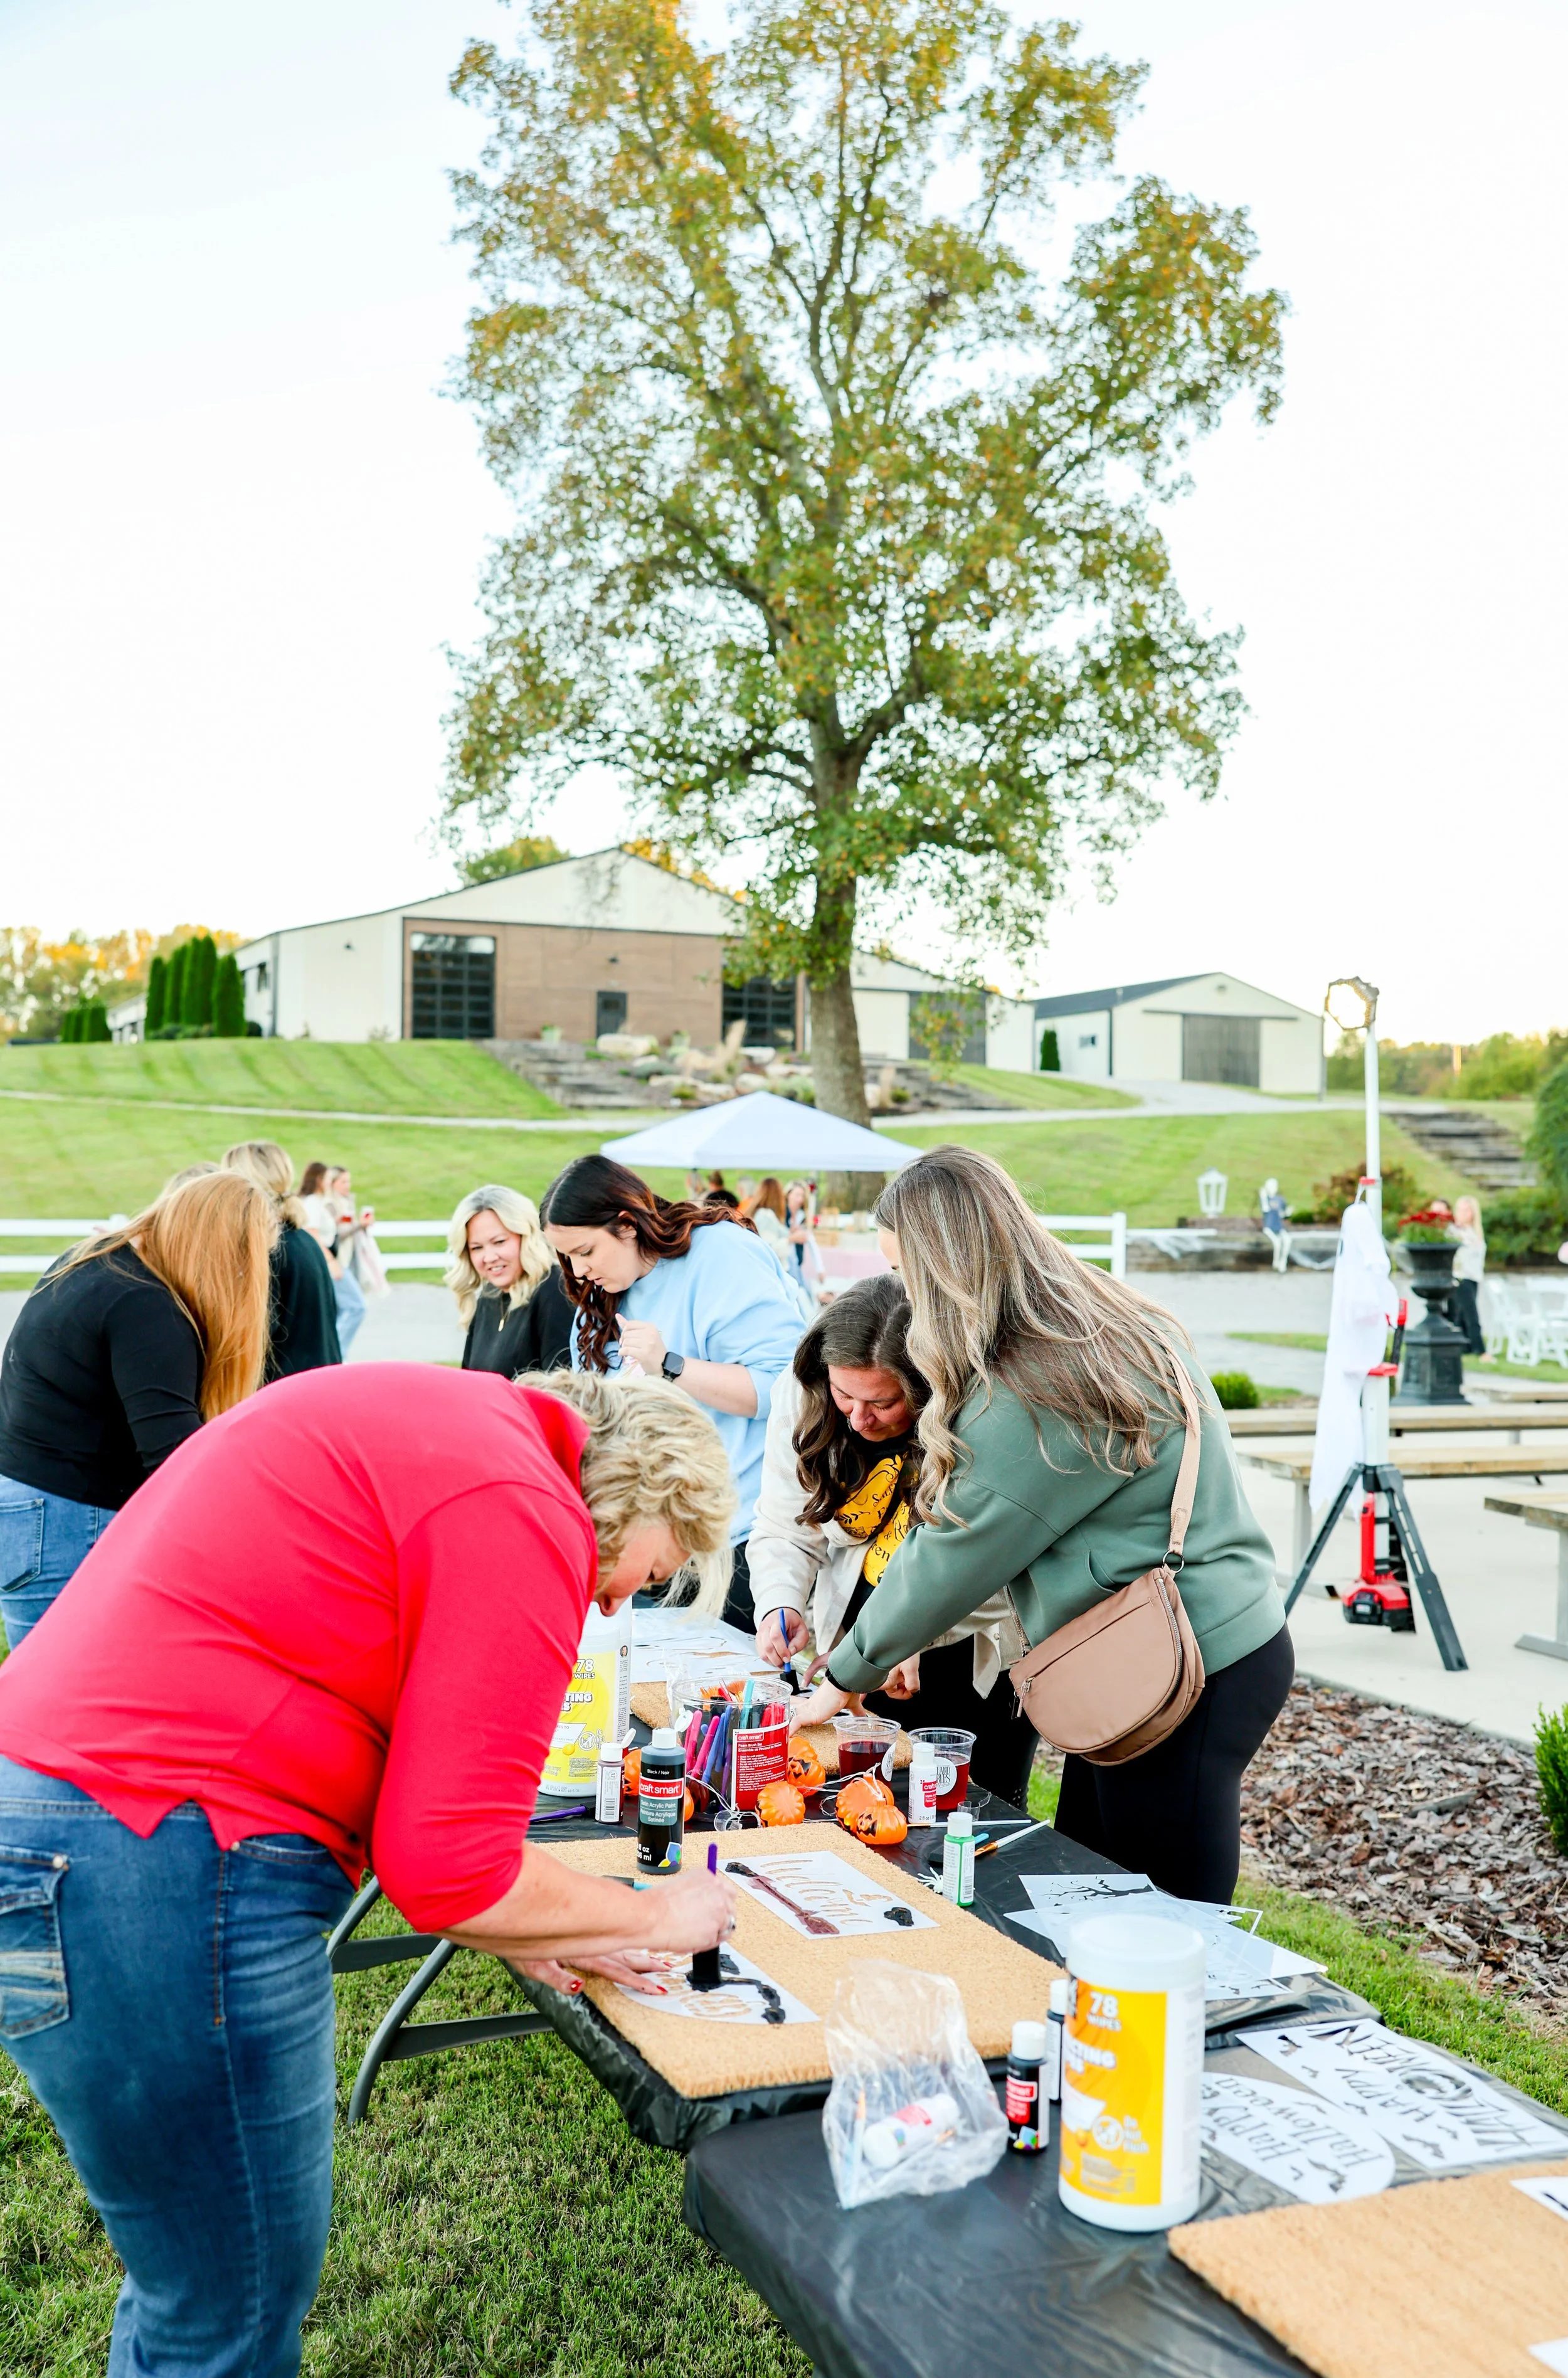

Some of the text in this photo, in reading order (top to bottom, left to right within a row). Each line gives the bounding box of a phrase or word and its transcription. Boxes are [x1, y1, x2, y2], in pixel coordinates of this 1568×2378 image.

[576, 1659, 594, 1672] 78
[640, 1782, 679, 1794] craft smart
[655, 1811, 676, 1819] Acrylique
[1089, 1990, 1118, 2019] 78
[1086, 2012, 1121, 2032] WIPES
[1214, 2077, 1387, 2168] Halloween
